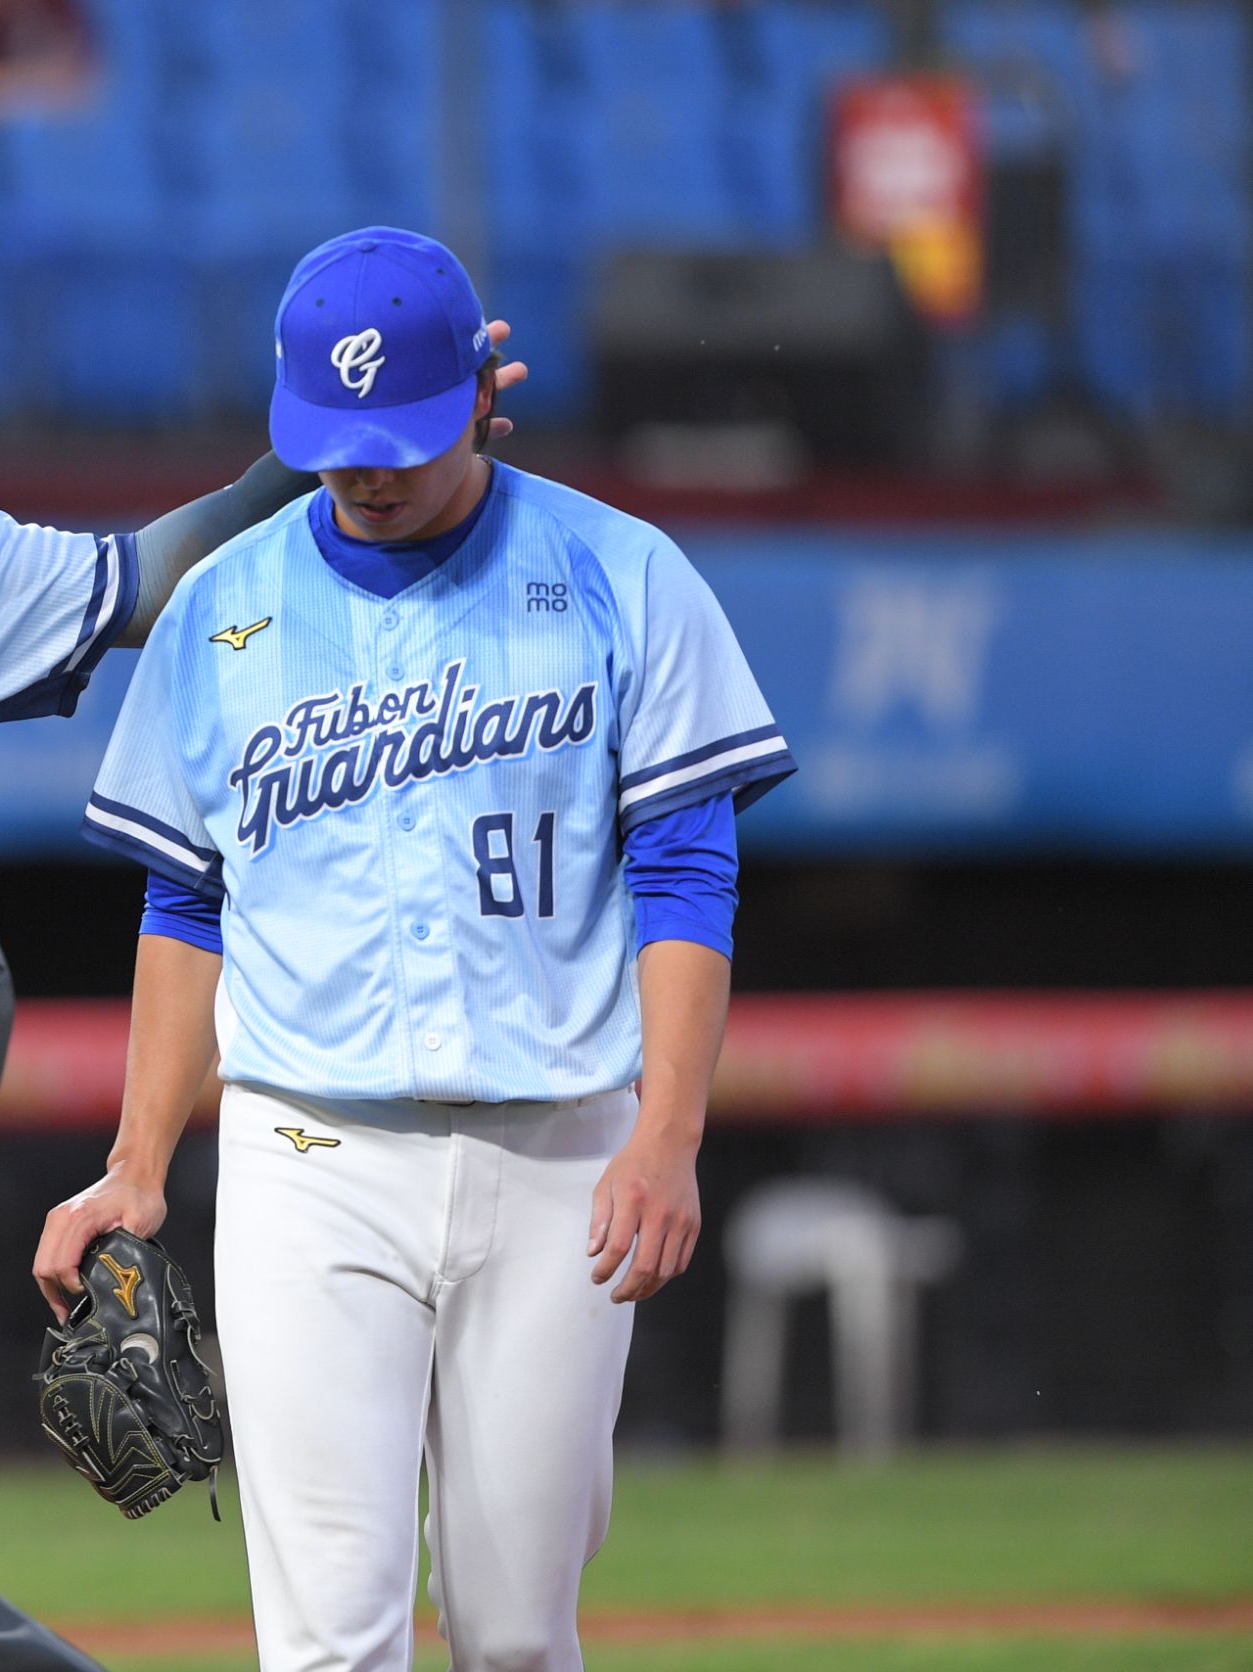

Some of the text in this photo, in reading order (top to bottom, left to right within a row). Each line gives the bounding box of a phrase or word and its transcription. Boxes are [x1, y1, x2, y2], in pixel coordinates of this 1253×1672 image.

[229, 657, 598, 856] Guardians
[283, 680, 438, 758] Fubon
[471, 811, 556, 918] 81
